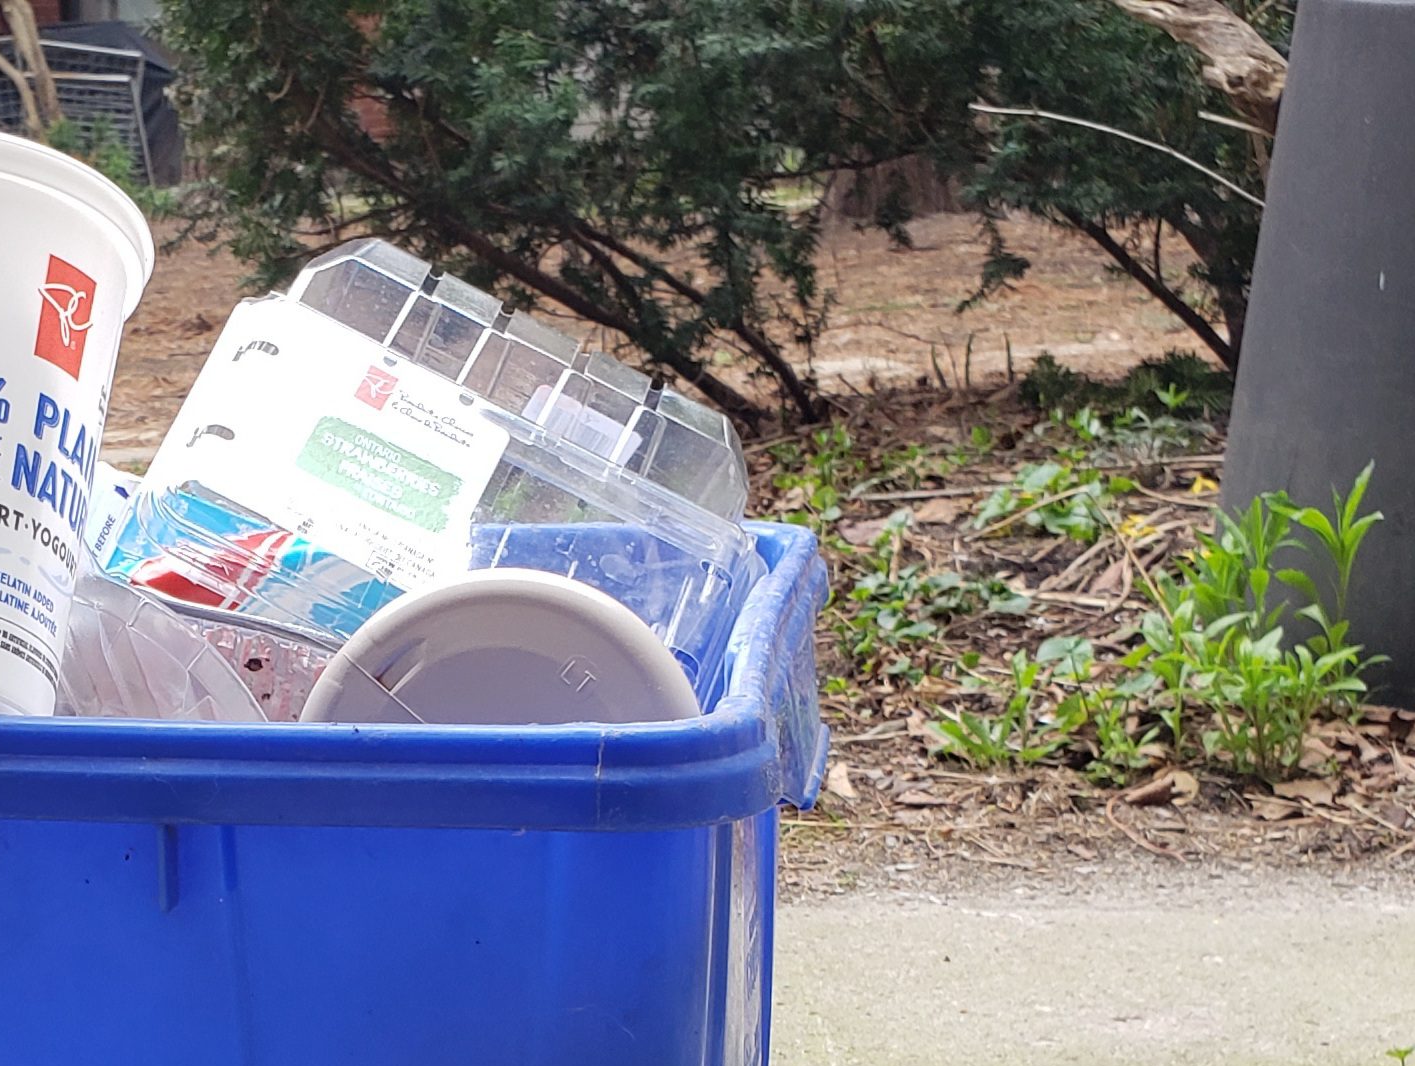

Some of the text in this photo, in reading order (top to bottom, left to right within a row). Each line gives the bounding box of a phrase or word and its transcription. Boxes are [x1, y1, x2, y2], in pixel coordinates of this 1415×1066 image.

[353, 434, 402, 464] ONTARIO
[94, 514, 116, 552] BEFORE
[32, 589, 54, 613] ADDED
